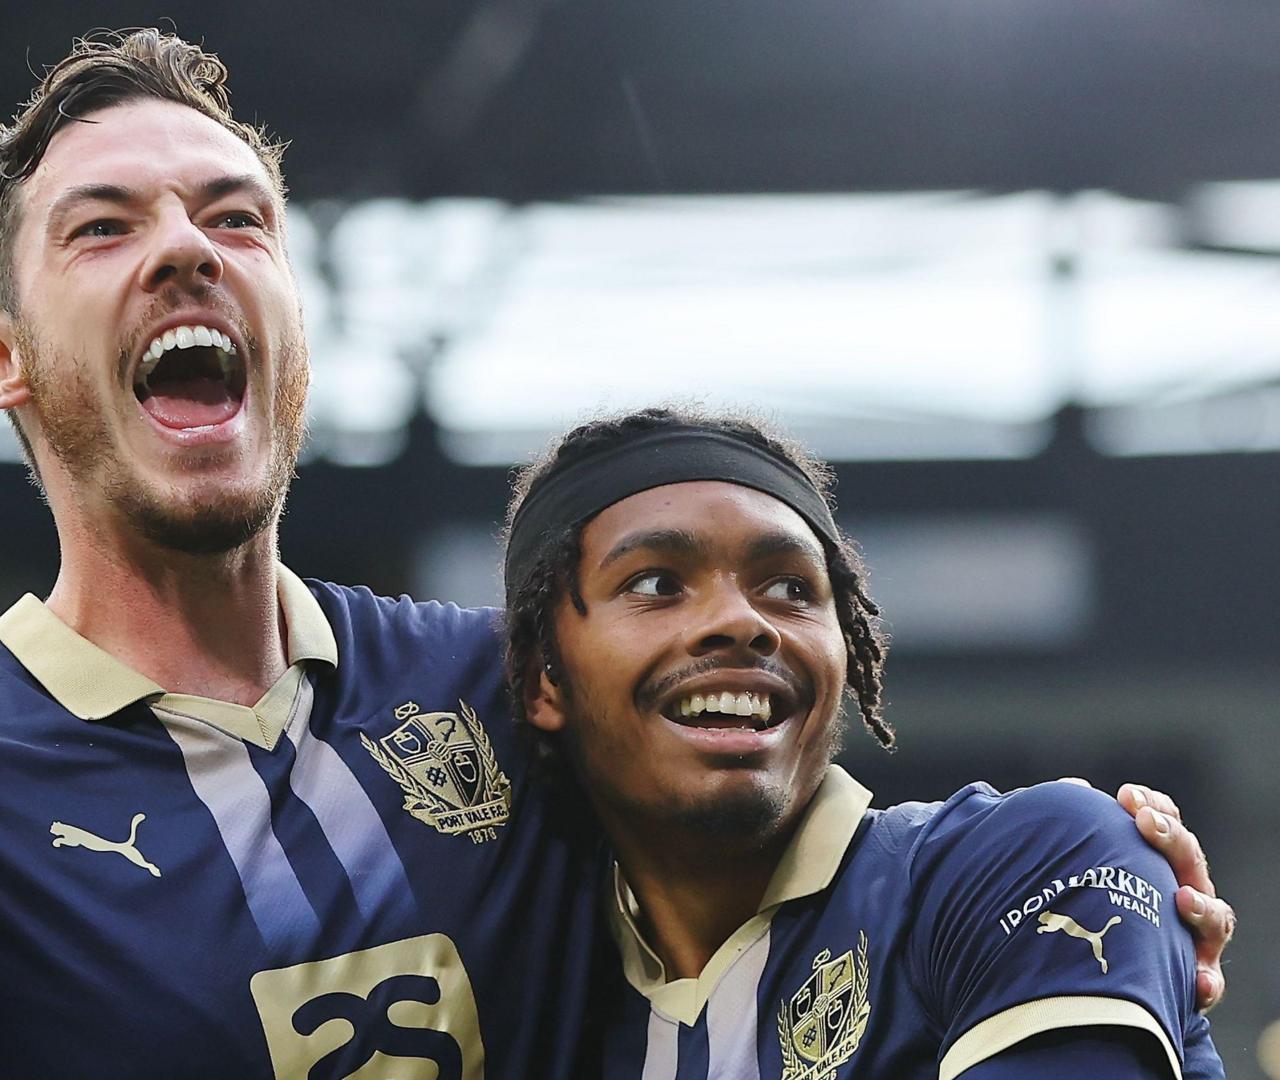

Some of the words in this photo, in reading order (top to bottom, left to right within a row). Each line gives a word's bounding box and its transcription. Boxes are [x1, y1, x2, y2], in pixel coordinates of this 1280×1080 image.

[437, 814, 466, 830] PORT
[466, 808, 491, 824] VALE
[1108, 890, 1160, 929] WEALTH
[816, 1052, 837, 1075] VALE
